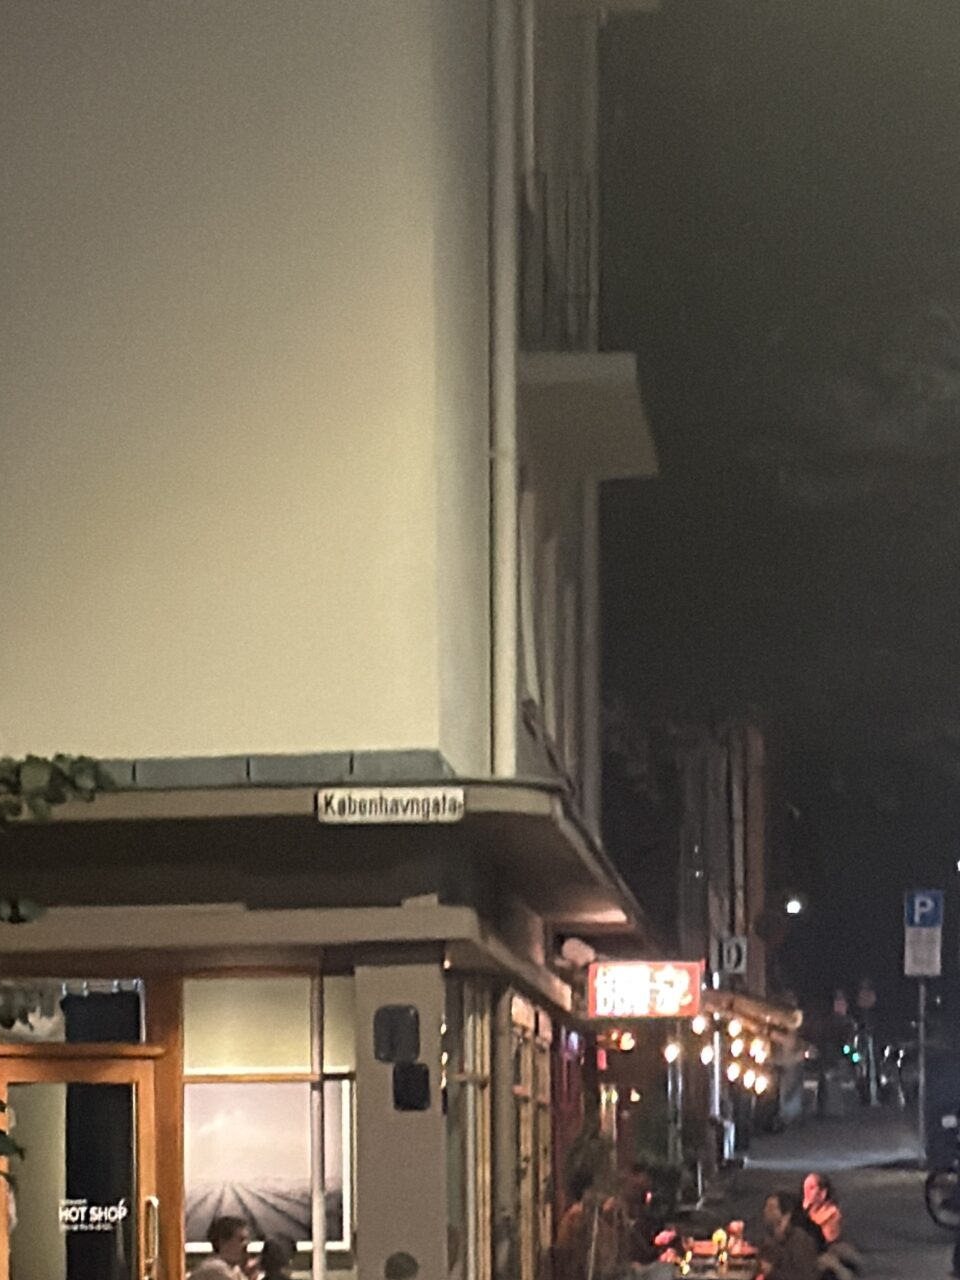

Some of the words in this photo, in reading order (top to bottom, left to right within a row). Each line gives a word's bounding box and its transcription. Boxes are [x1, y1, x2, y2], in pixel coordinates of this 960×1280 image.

[914, 895, 935, 924] P
[58, 1205, 88, 1222] HOT
[89, 1198, 128, 1223] SHOP
